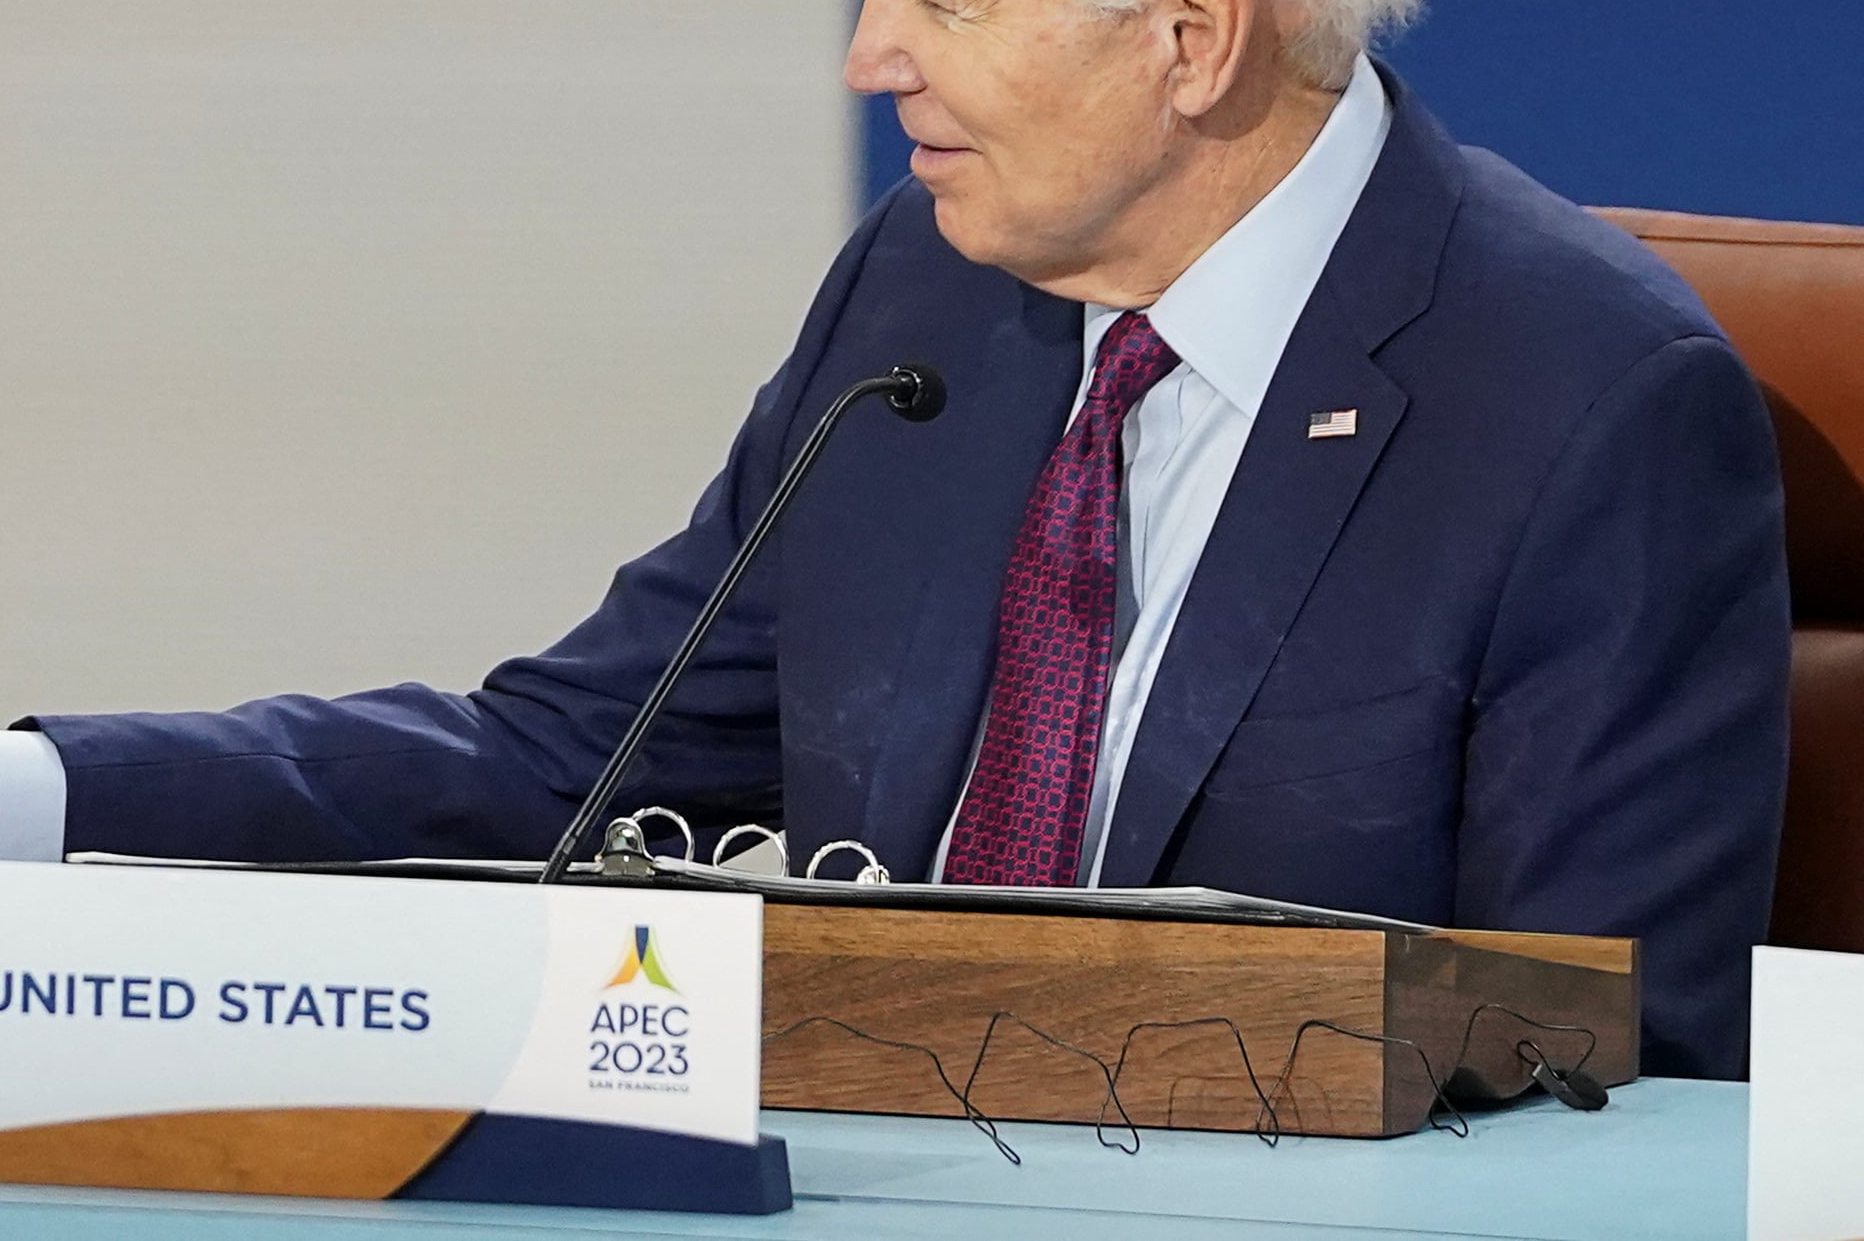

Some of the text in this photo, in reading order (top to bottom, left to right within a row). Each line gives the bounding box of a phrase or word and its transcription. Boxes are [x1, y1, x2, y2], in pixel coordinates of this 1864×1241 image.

[218, 981, 431, 1032] STATES
[590, 1002, 689, 1037] APEC
[589, 1041, 689, 1076] 2023
